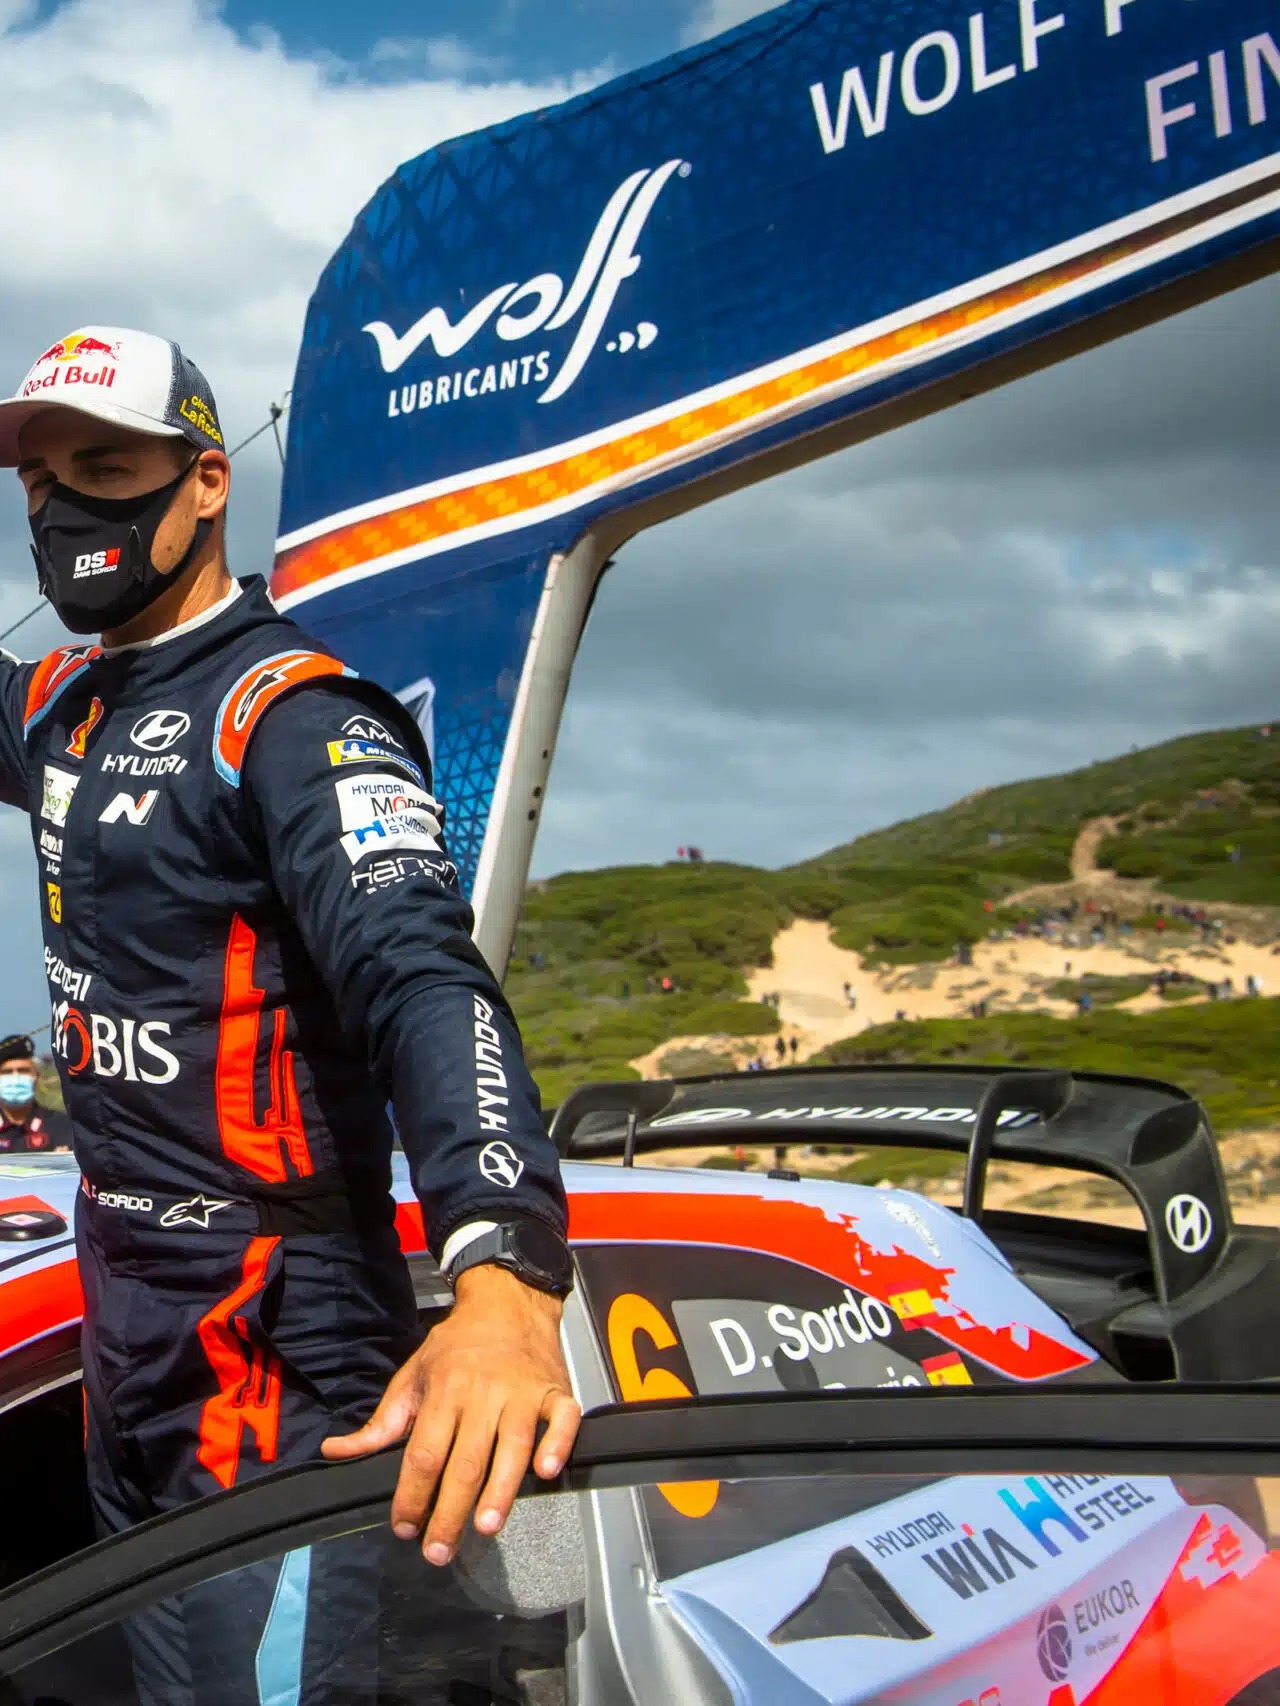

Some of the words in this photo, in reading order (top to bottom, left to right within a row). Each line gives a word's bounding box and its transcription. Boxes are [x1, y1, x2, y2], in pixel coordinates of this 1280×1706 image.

[809, 0, 1065, 154] WOLF
[23, 367, 59, 397] Red
[64, 366, 116, 387] Bull
[387, 351, 550, 418] LUBRICANTS
[75, 551, 107, 573] DS
[100, 754, 188, 776] HYUNDAI
[352, 784, 405, 795] HYUNDAI
[474, 994, 510, 1134] HYUNDAI
[98, 1192, 153, 1212] SORDO
[709, 1317, 773, 1377] D.
[767, 1288, 892, 1361] Sordo
[1074, 1481, 1156, 1531] STEEL
[865, 1510, 956, 1559] HYUNDAI
[1074, 1579, 1140, 1634] EUKOR
